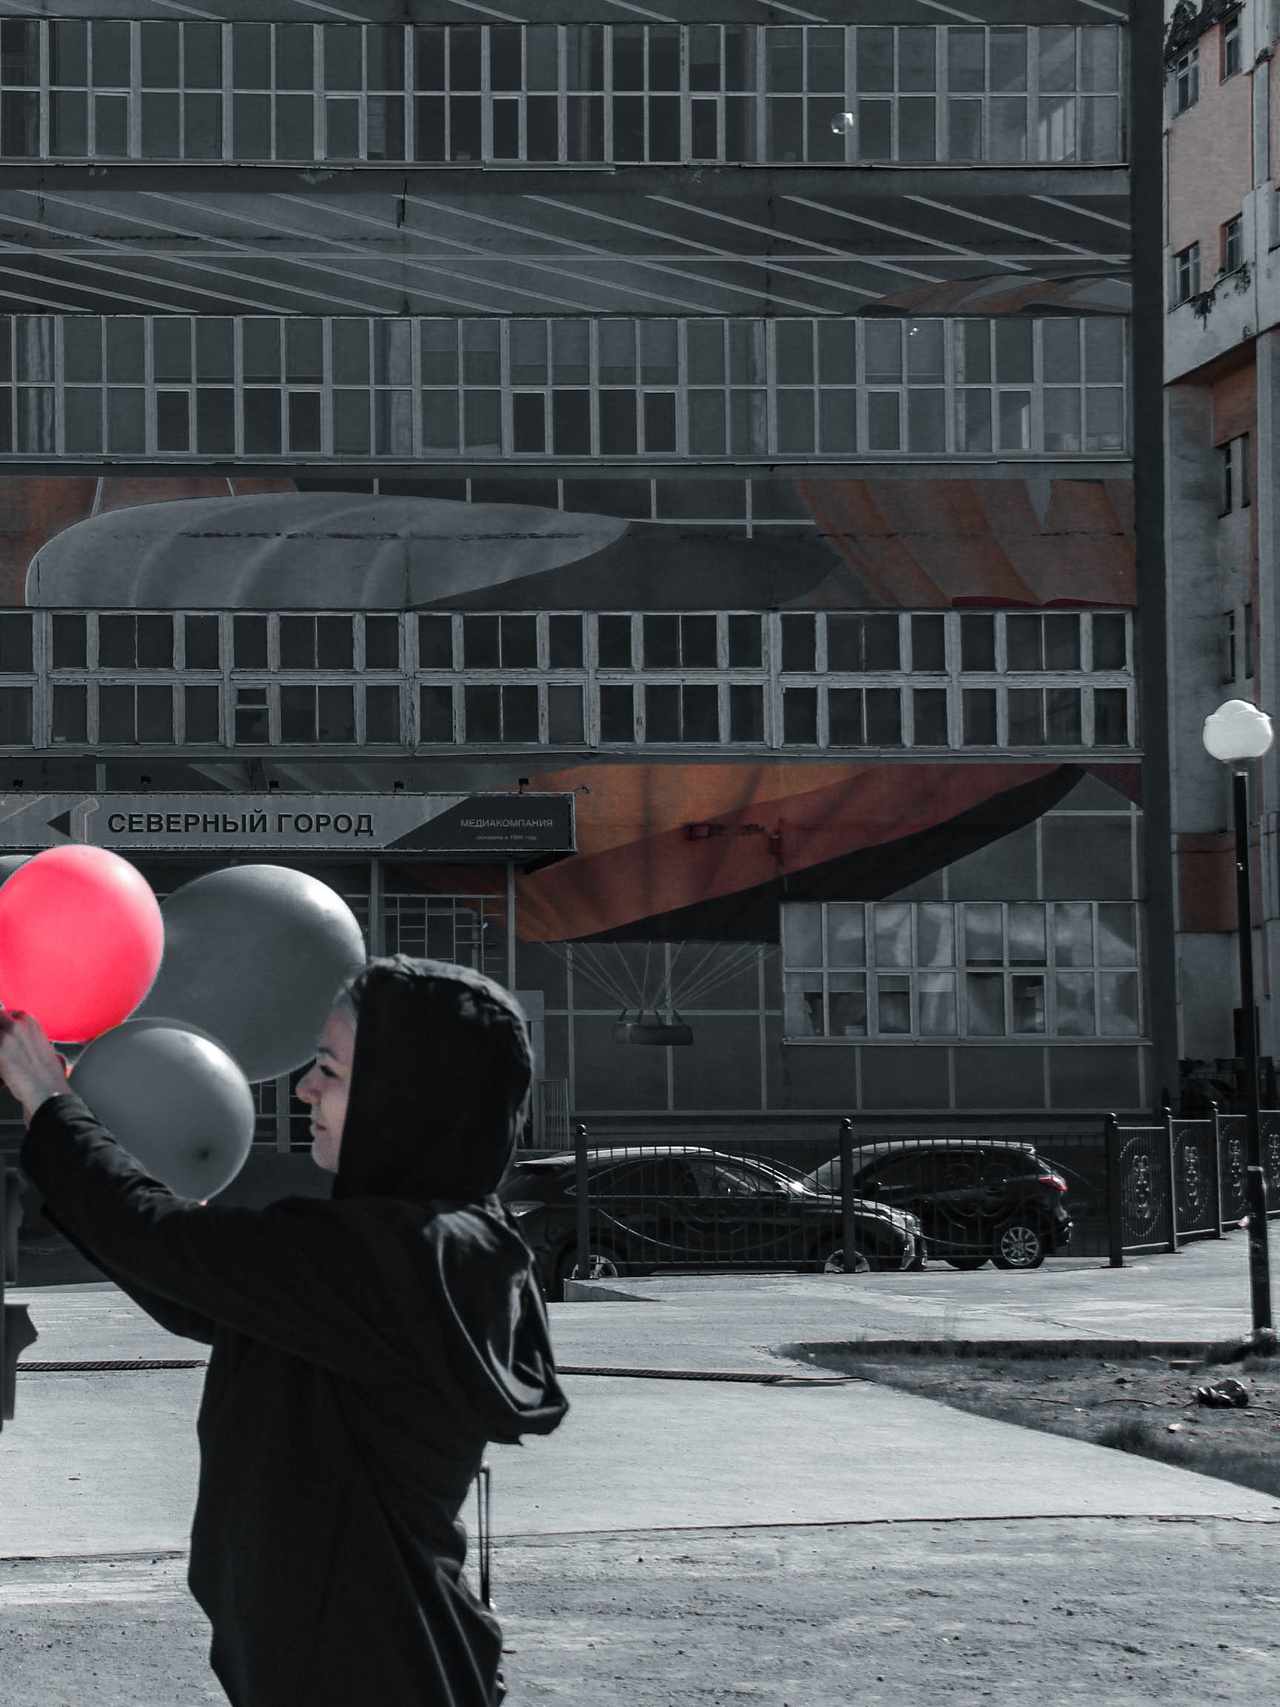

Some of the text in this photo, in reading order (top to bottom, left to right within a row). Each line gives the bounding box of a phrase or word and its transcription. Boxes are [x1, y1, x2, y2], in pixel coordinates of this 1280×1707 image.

[107, 808, 374, 837] СЕВЕРНЫЙ ГОРОД
[460, 818, 553, 828] МЕДИАКОМПАНИЯ
